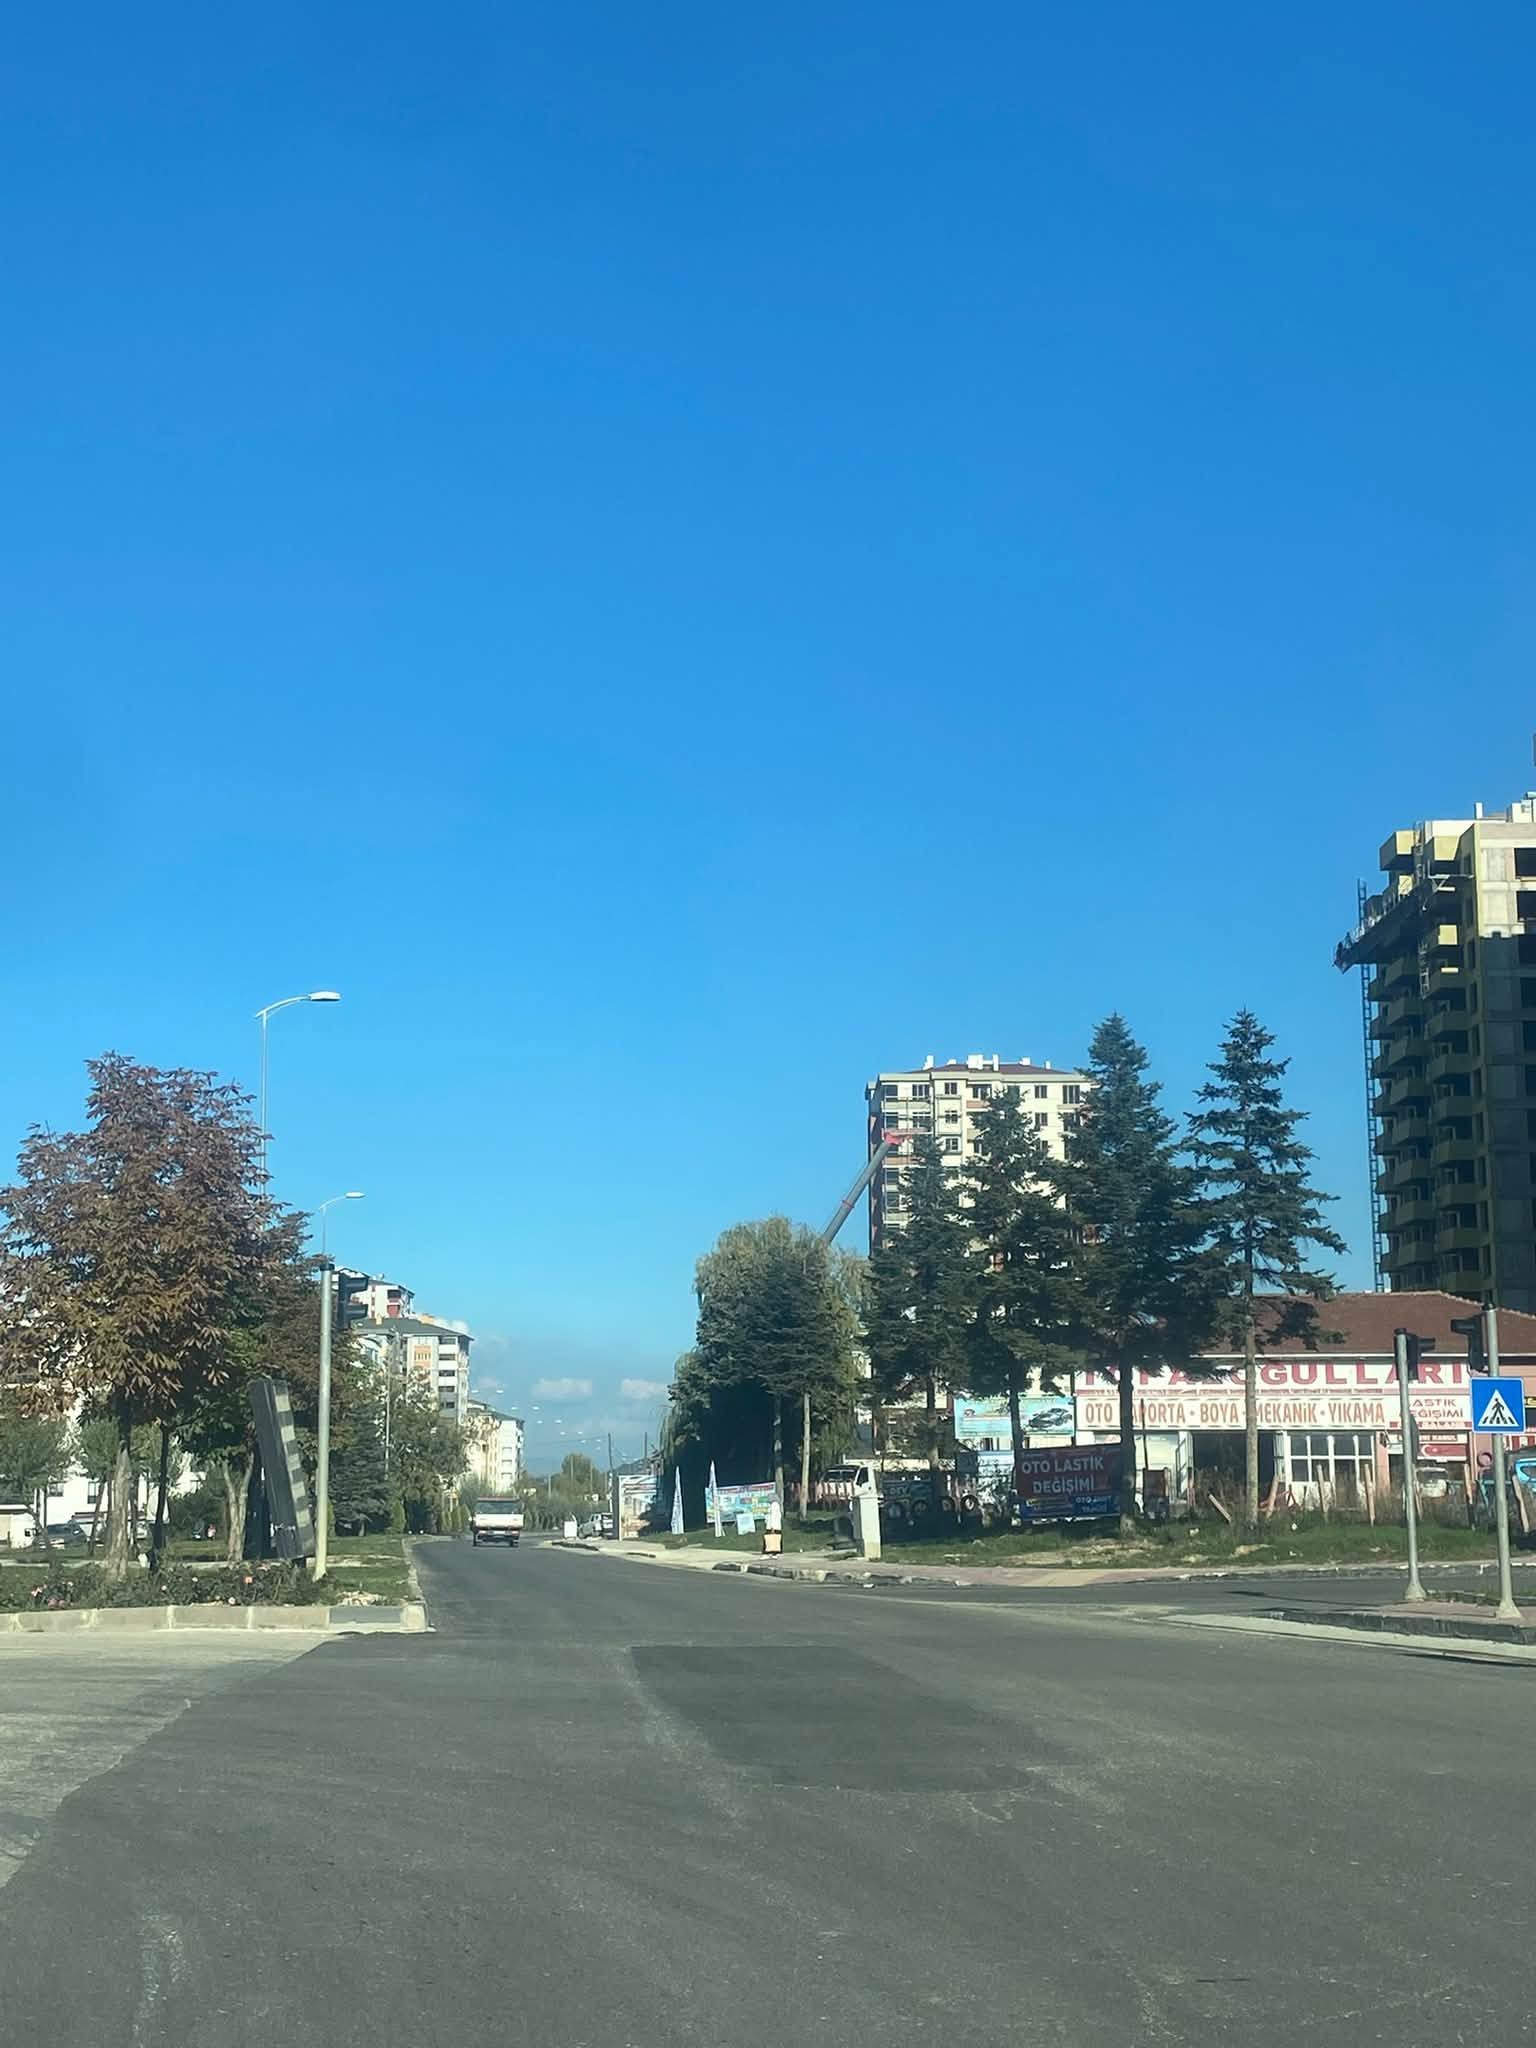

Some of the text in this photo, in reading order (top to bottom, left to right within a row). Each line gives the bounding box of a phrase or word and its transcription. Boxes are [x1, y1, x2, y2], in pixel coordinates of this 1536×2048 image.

[1085, 1403, 1113, 1424] OTO
[1122, 1403, 1186, 1424] PORTA
[1200, 1403, 1239, 1424] BOYA
[1328, 1403, 1385, 1423] YIKAMA
[1400, 1408, 1464, 1420] EĞİŞİMİ
[1022, 1460, 1051, 1474] OTO
